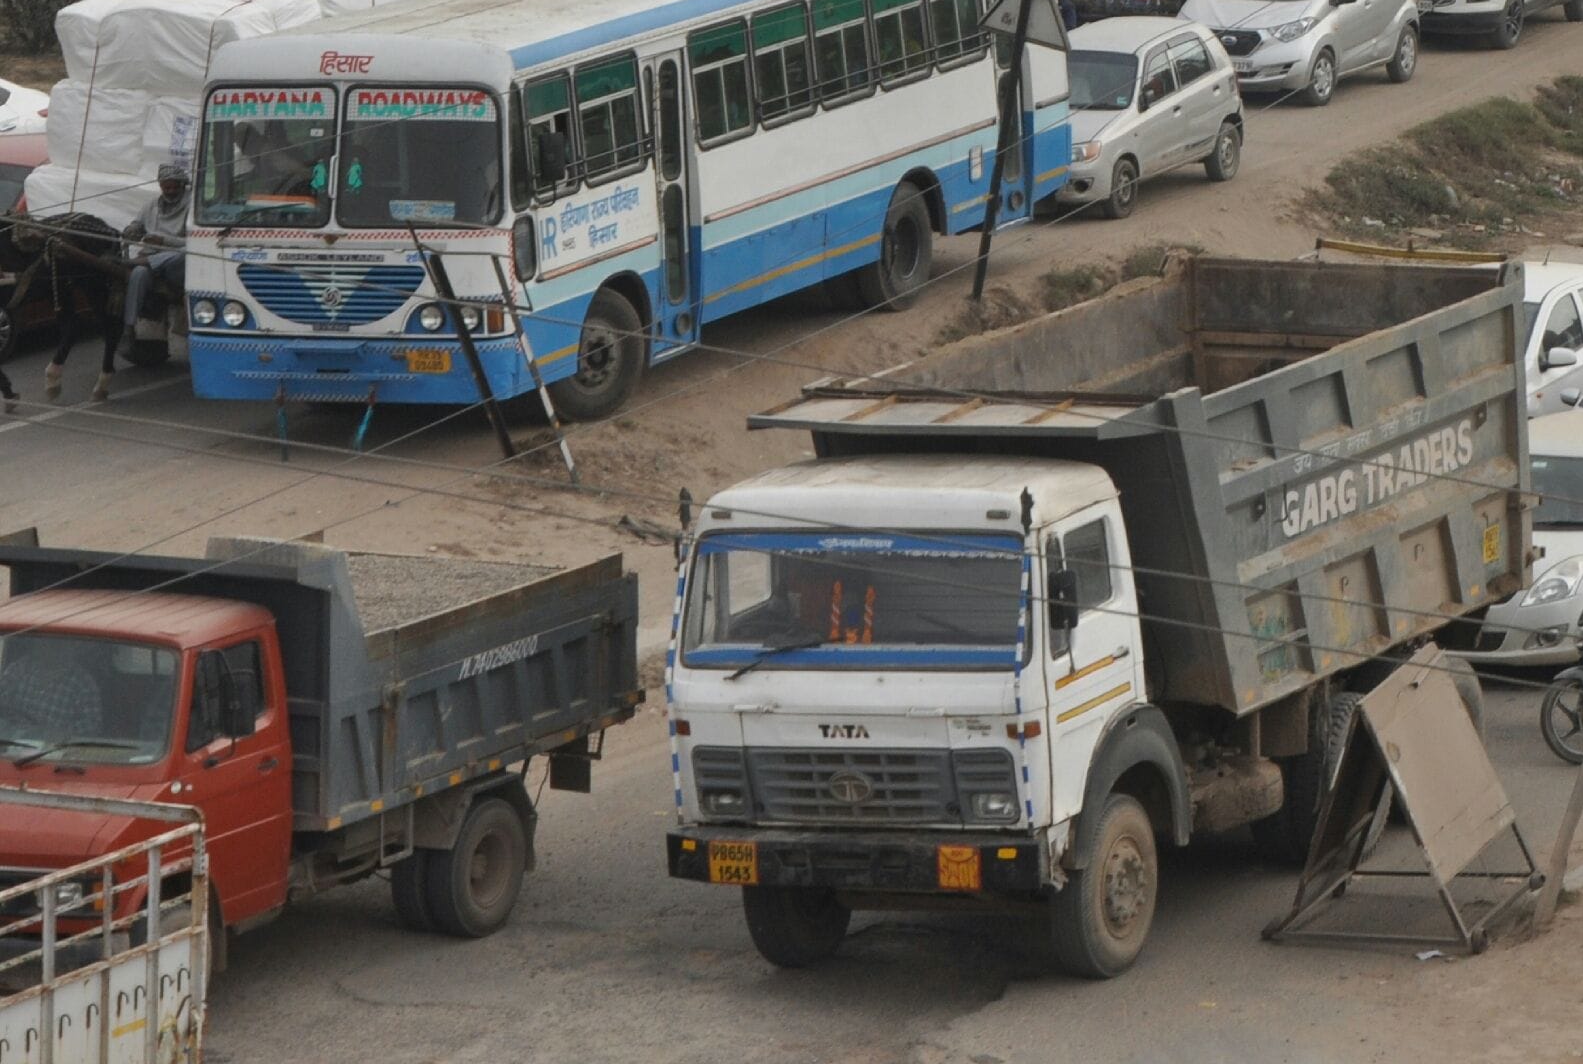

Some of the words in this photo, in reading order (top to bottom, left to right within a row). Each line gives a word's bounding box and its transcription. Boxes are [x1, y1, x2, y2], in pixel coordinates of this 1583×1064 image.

[319, 51, 375, 76] हिसार
[212, 90, 325, 117] HARYANA
[357, 90, 487, 118] ROADWAYS
[1281, 469, 1357, 536] GARG
[1362, 418, 1474, 505] TRADERS
[818, 724, 870, 739] TATA
[712, 844, 755, 862] PB65H
[719, 865, 751, 881] 1543
